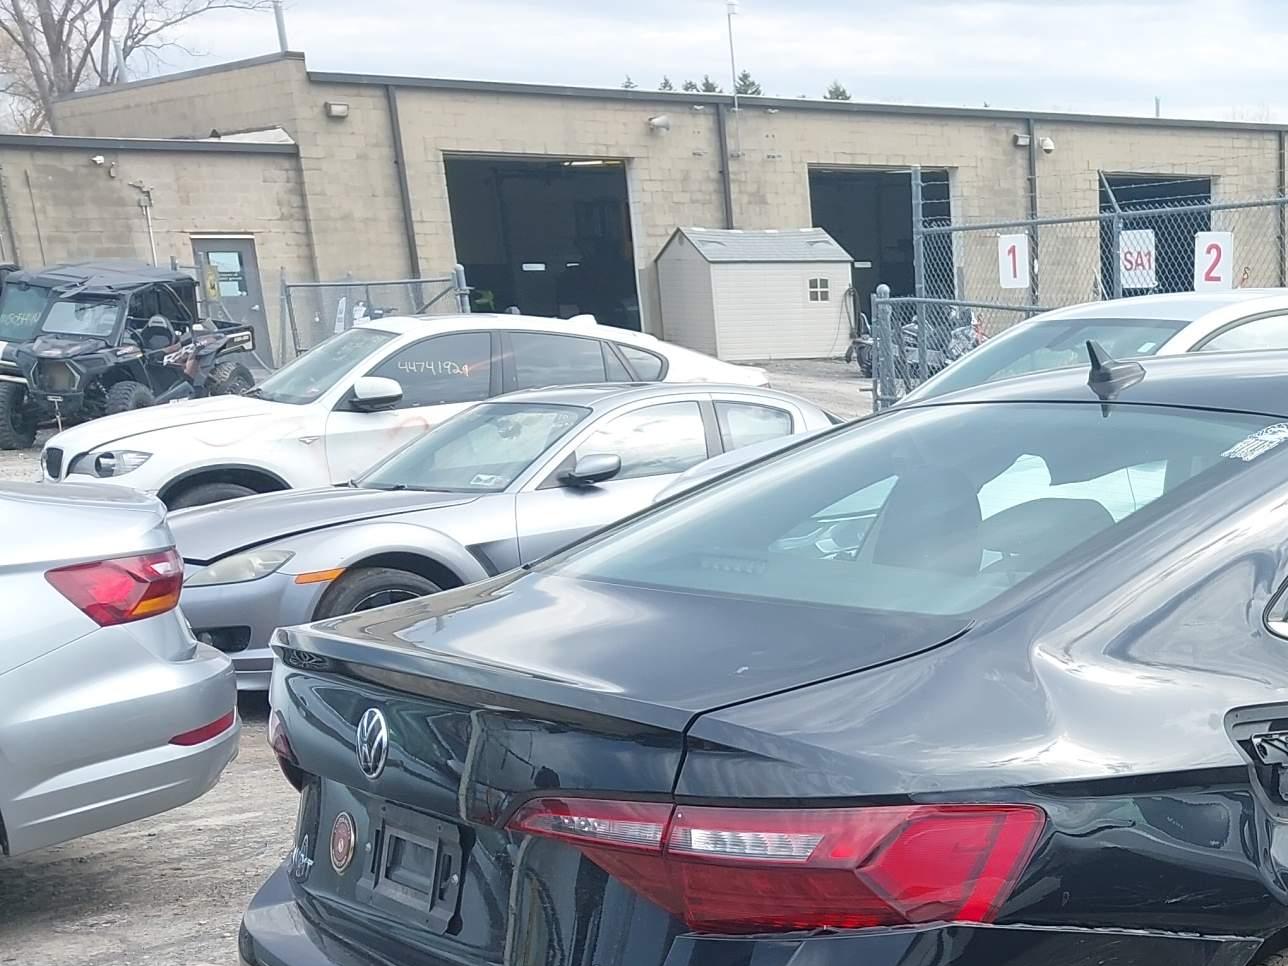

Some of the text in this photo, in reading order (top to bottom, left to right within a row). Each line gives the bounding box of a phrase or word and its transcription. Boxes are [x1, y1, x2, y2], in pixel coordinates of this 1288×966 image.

[1007, 244, 1017, 279] 1
[1124, 250, 1152, 271] SA1
[1204, 243, 1222, 282] 2
